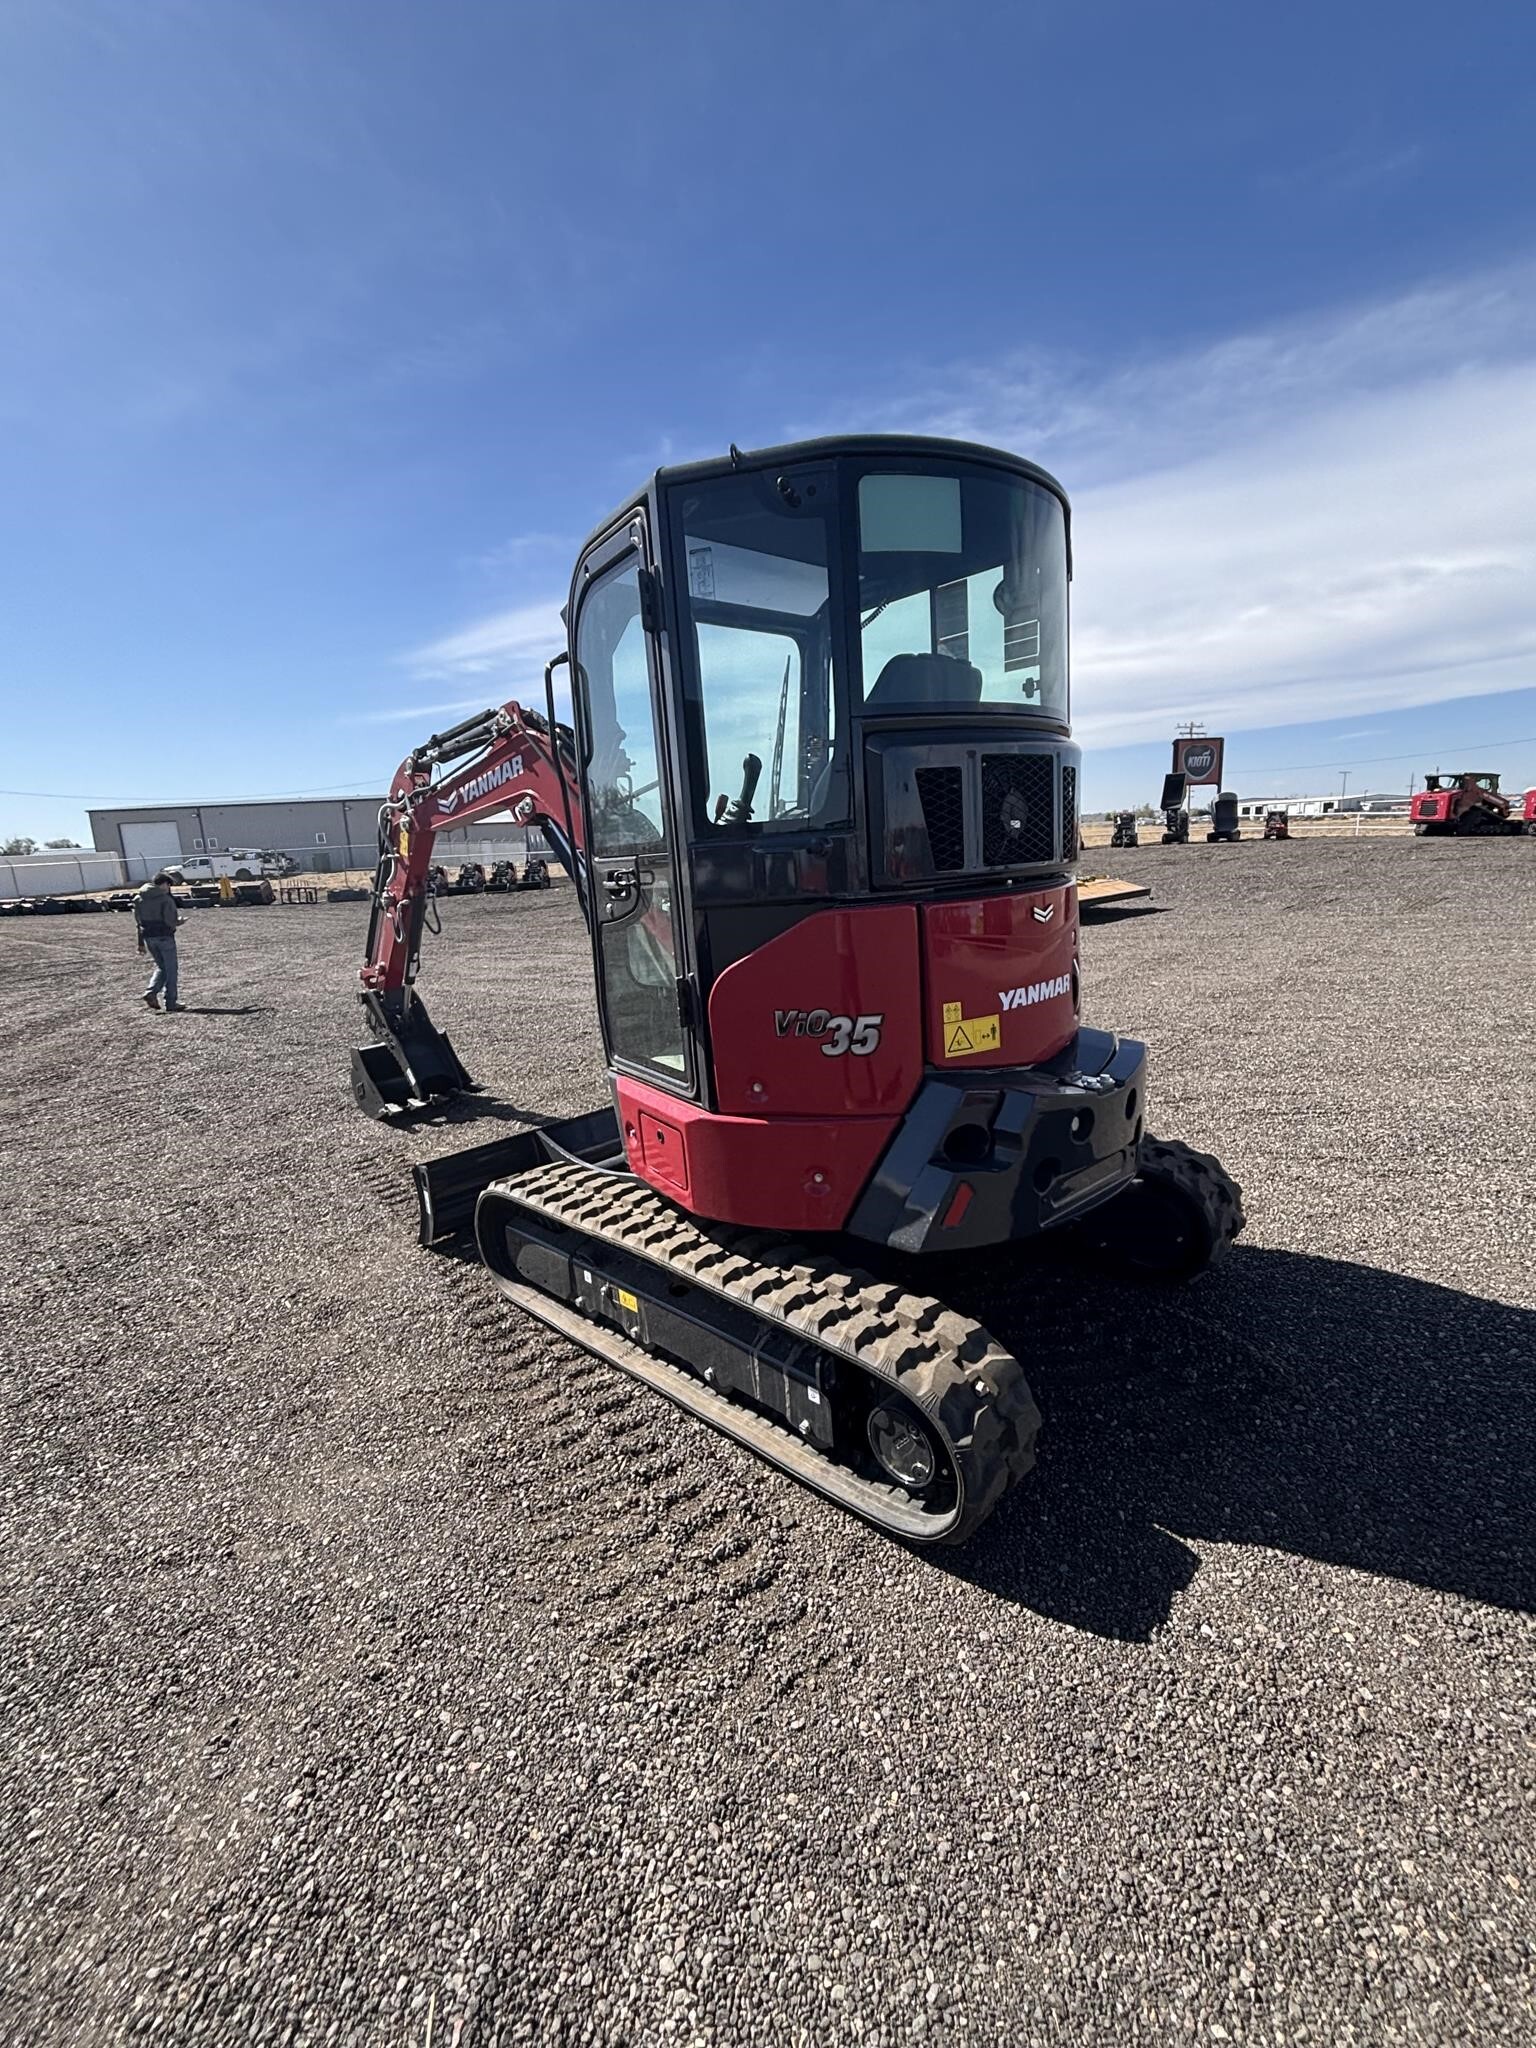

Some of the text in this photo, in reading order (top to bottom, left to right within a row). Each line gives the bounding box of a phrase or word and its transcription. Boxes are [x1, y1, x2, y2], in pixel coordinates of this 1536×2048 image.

[459, 754, 524, 804] YANMAR
[1187, 753, 1211, 767] KIOTI
[998, 973, 1071, 1011] YANMAR
